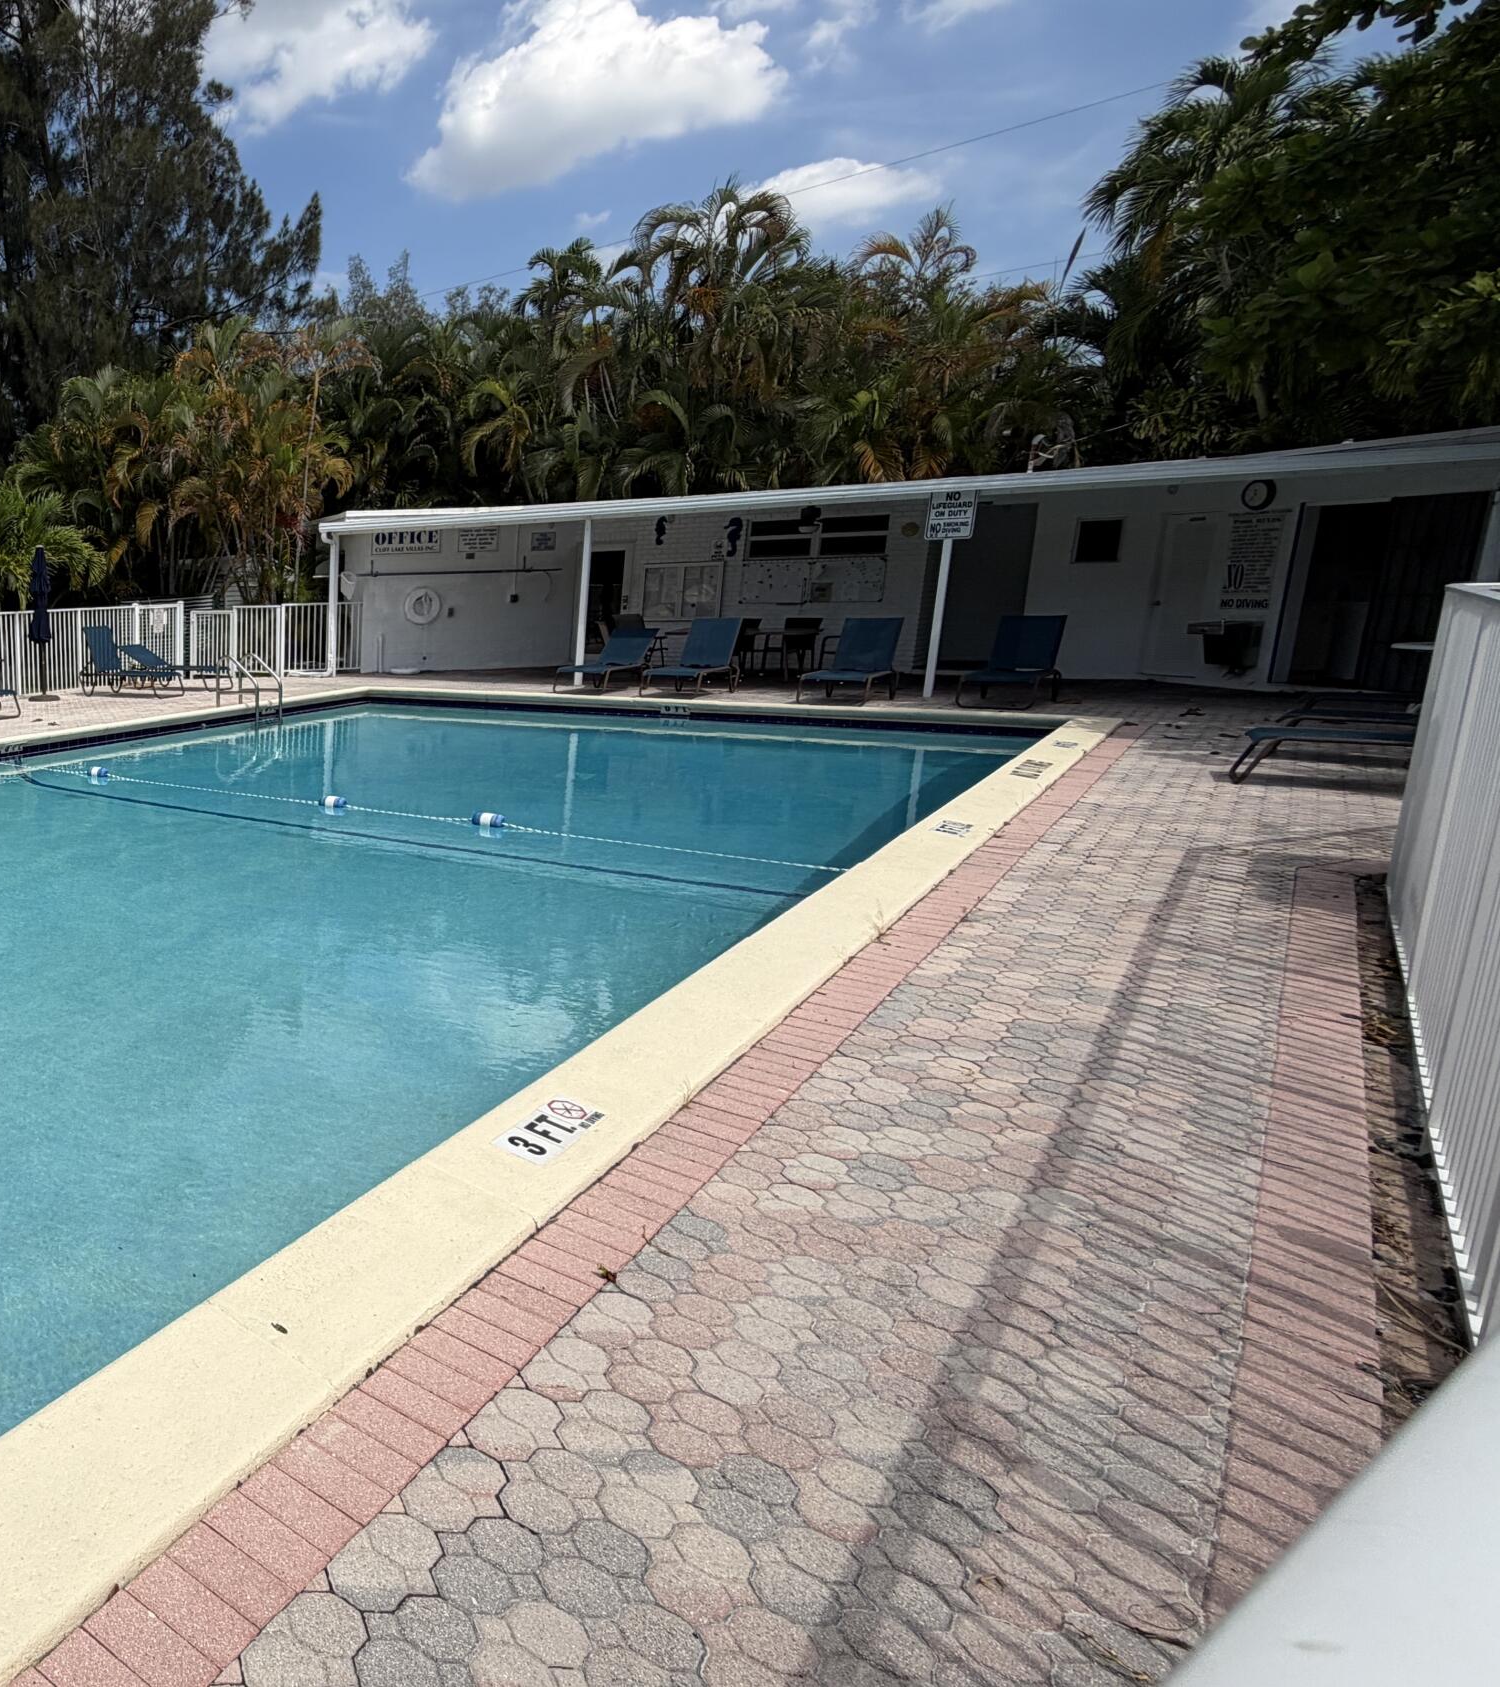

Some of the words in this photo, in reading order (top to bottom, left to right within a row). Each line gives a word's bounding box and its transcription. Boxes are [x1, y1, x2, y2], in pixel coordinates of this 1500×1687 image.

[946, 491, 961, 501] NO
[932, 501, 973, 510] LIFEGUARD
[948, 509, 968, 517] DUTY
[930, 522, 941, 533] NO
[375, 530, 438, 545] OFFICE
[1220, 599, 1234, 608] NO
[1236, 599, 1268, 608] DIVING
[524, 1114, 577, 1144] FT.
[508, 1136, 547, 1155] 3
